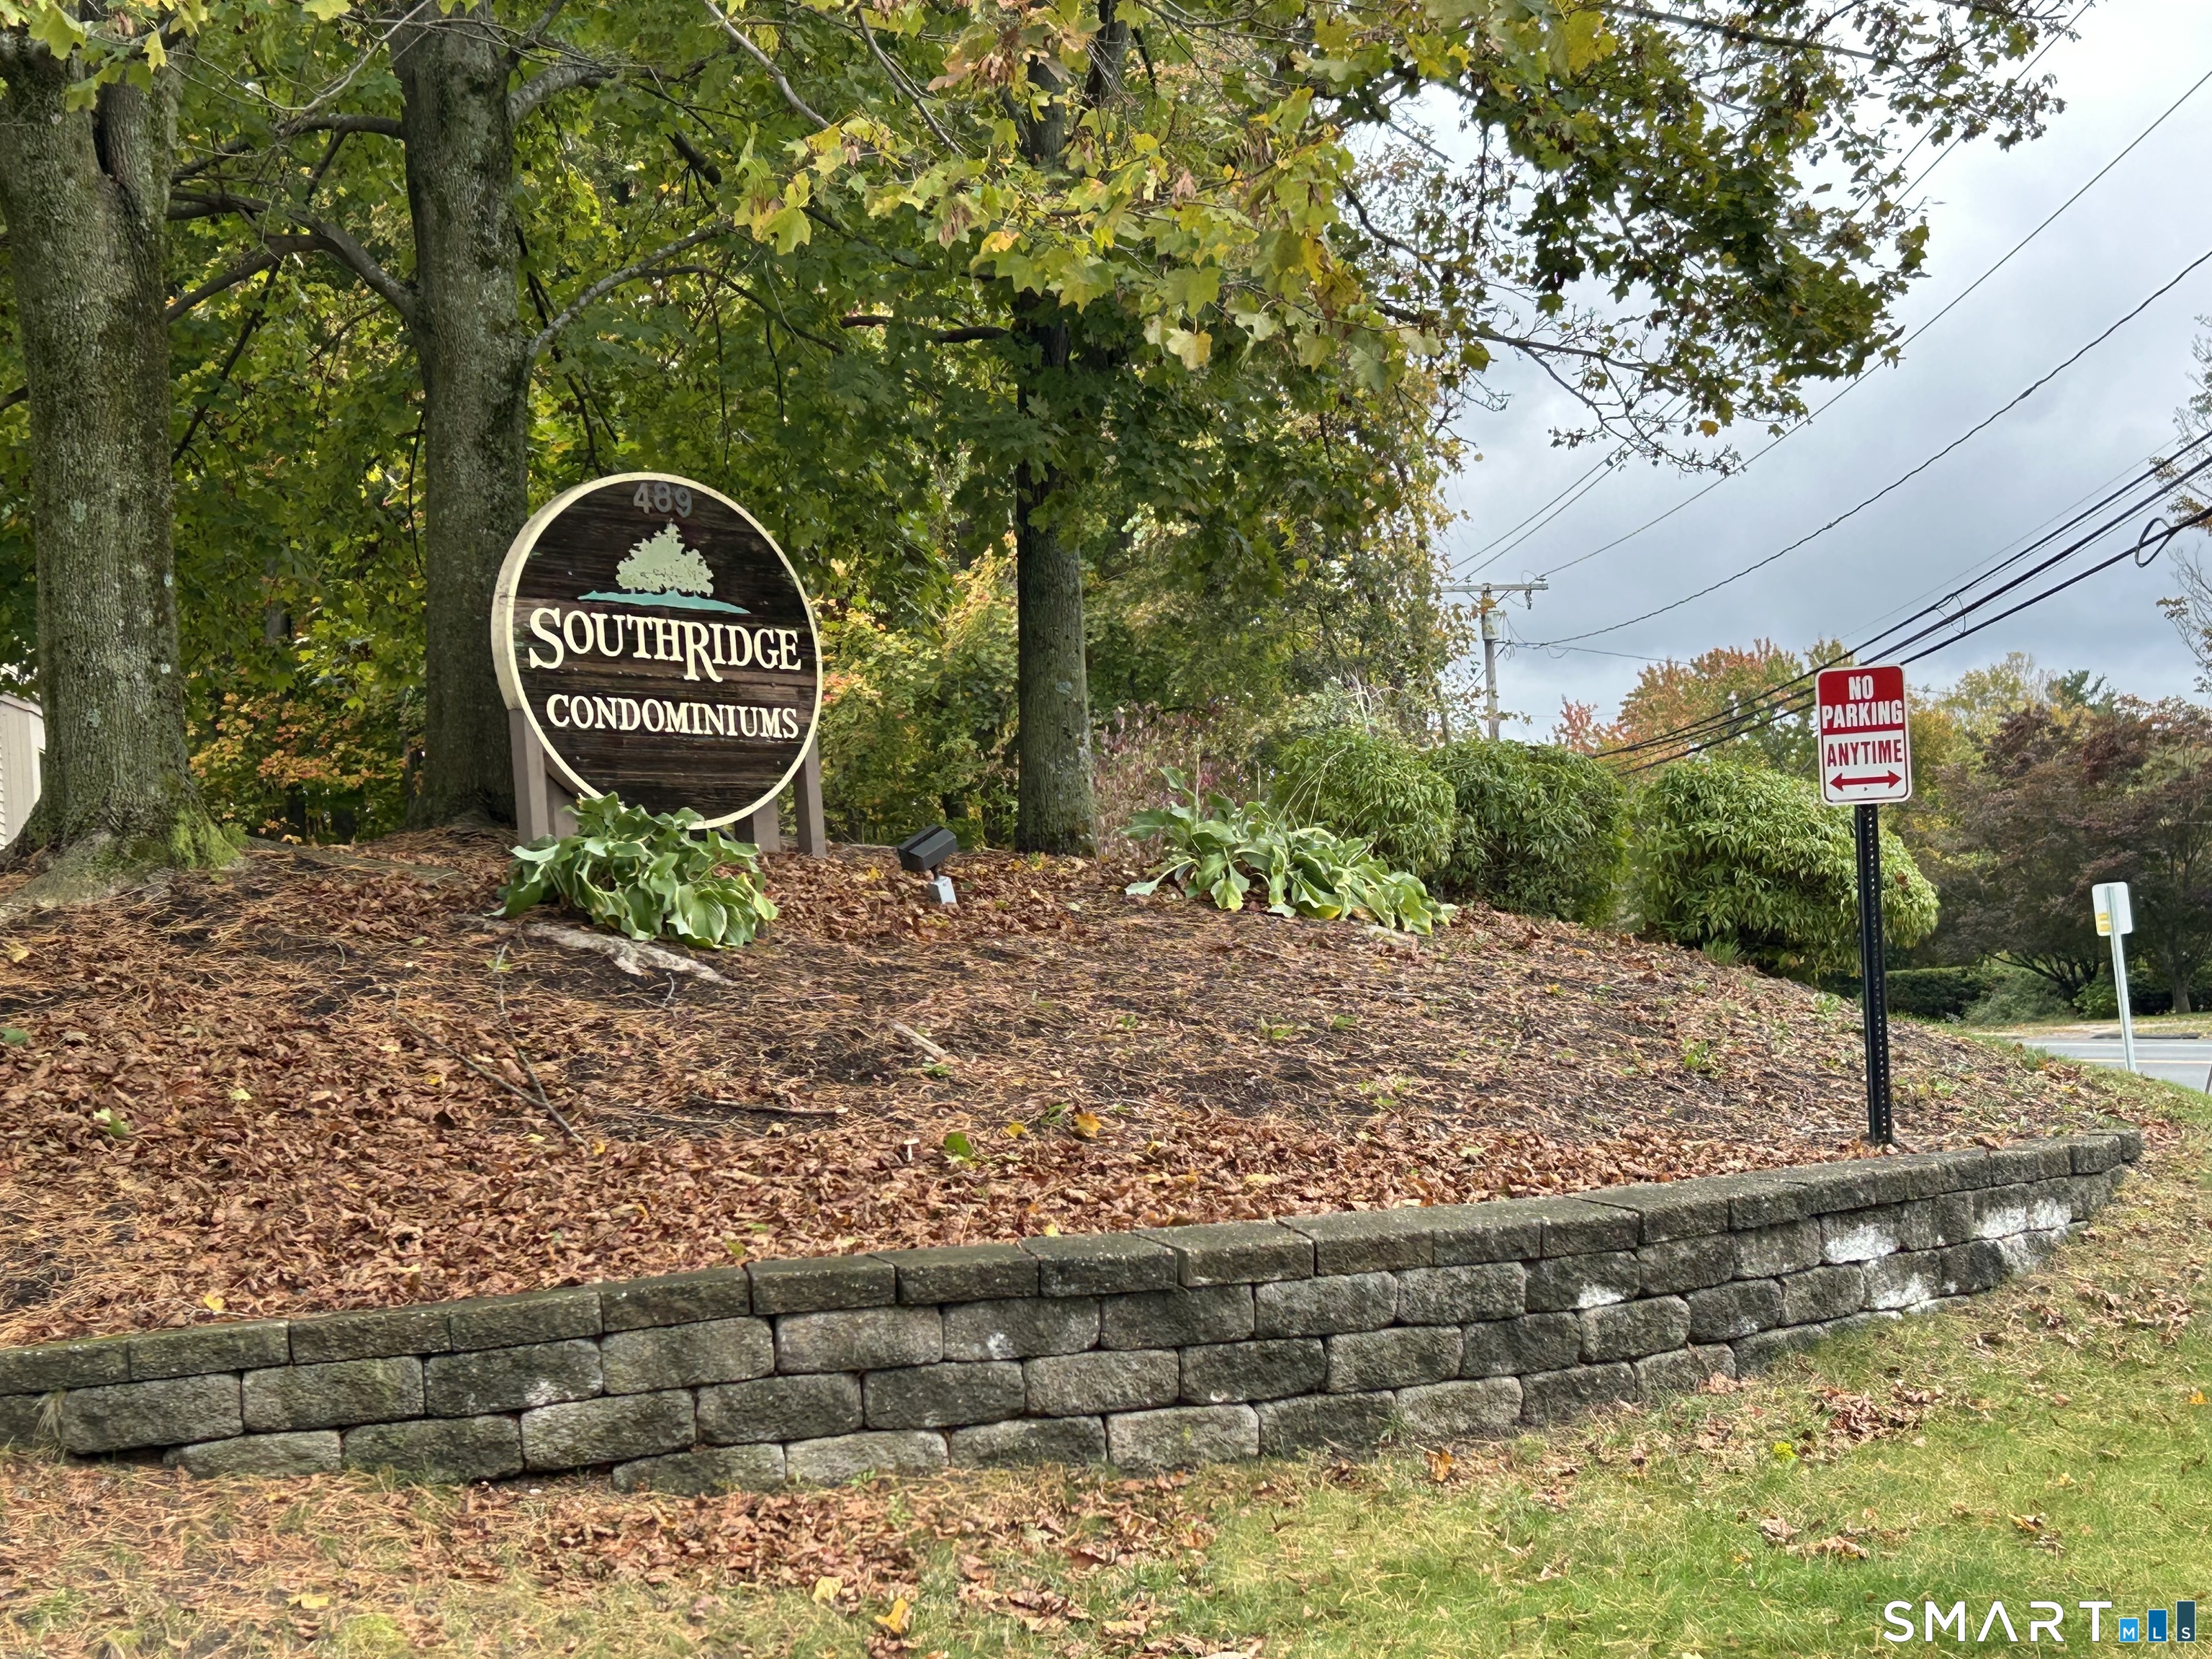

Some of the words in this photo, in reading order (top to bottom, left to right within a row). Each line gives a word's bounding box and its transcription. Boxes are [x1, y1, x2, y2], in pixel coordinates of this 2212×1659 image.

[633, 482, 692, 518] 489
[529, 607, 801, 683] SOUTHRIDGE
[1848, 675, 1874, 700] NO
[546, 694, 799, 739] CONDOMINIUMS
[1822, 699, 1902, 729] PARKING
[1827, 739, 1902, 767] ANYTIME
